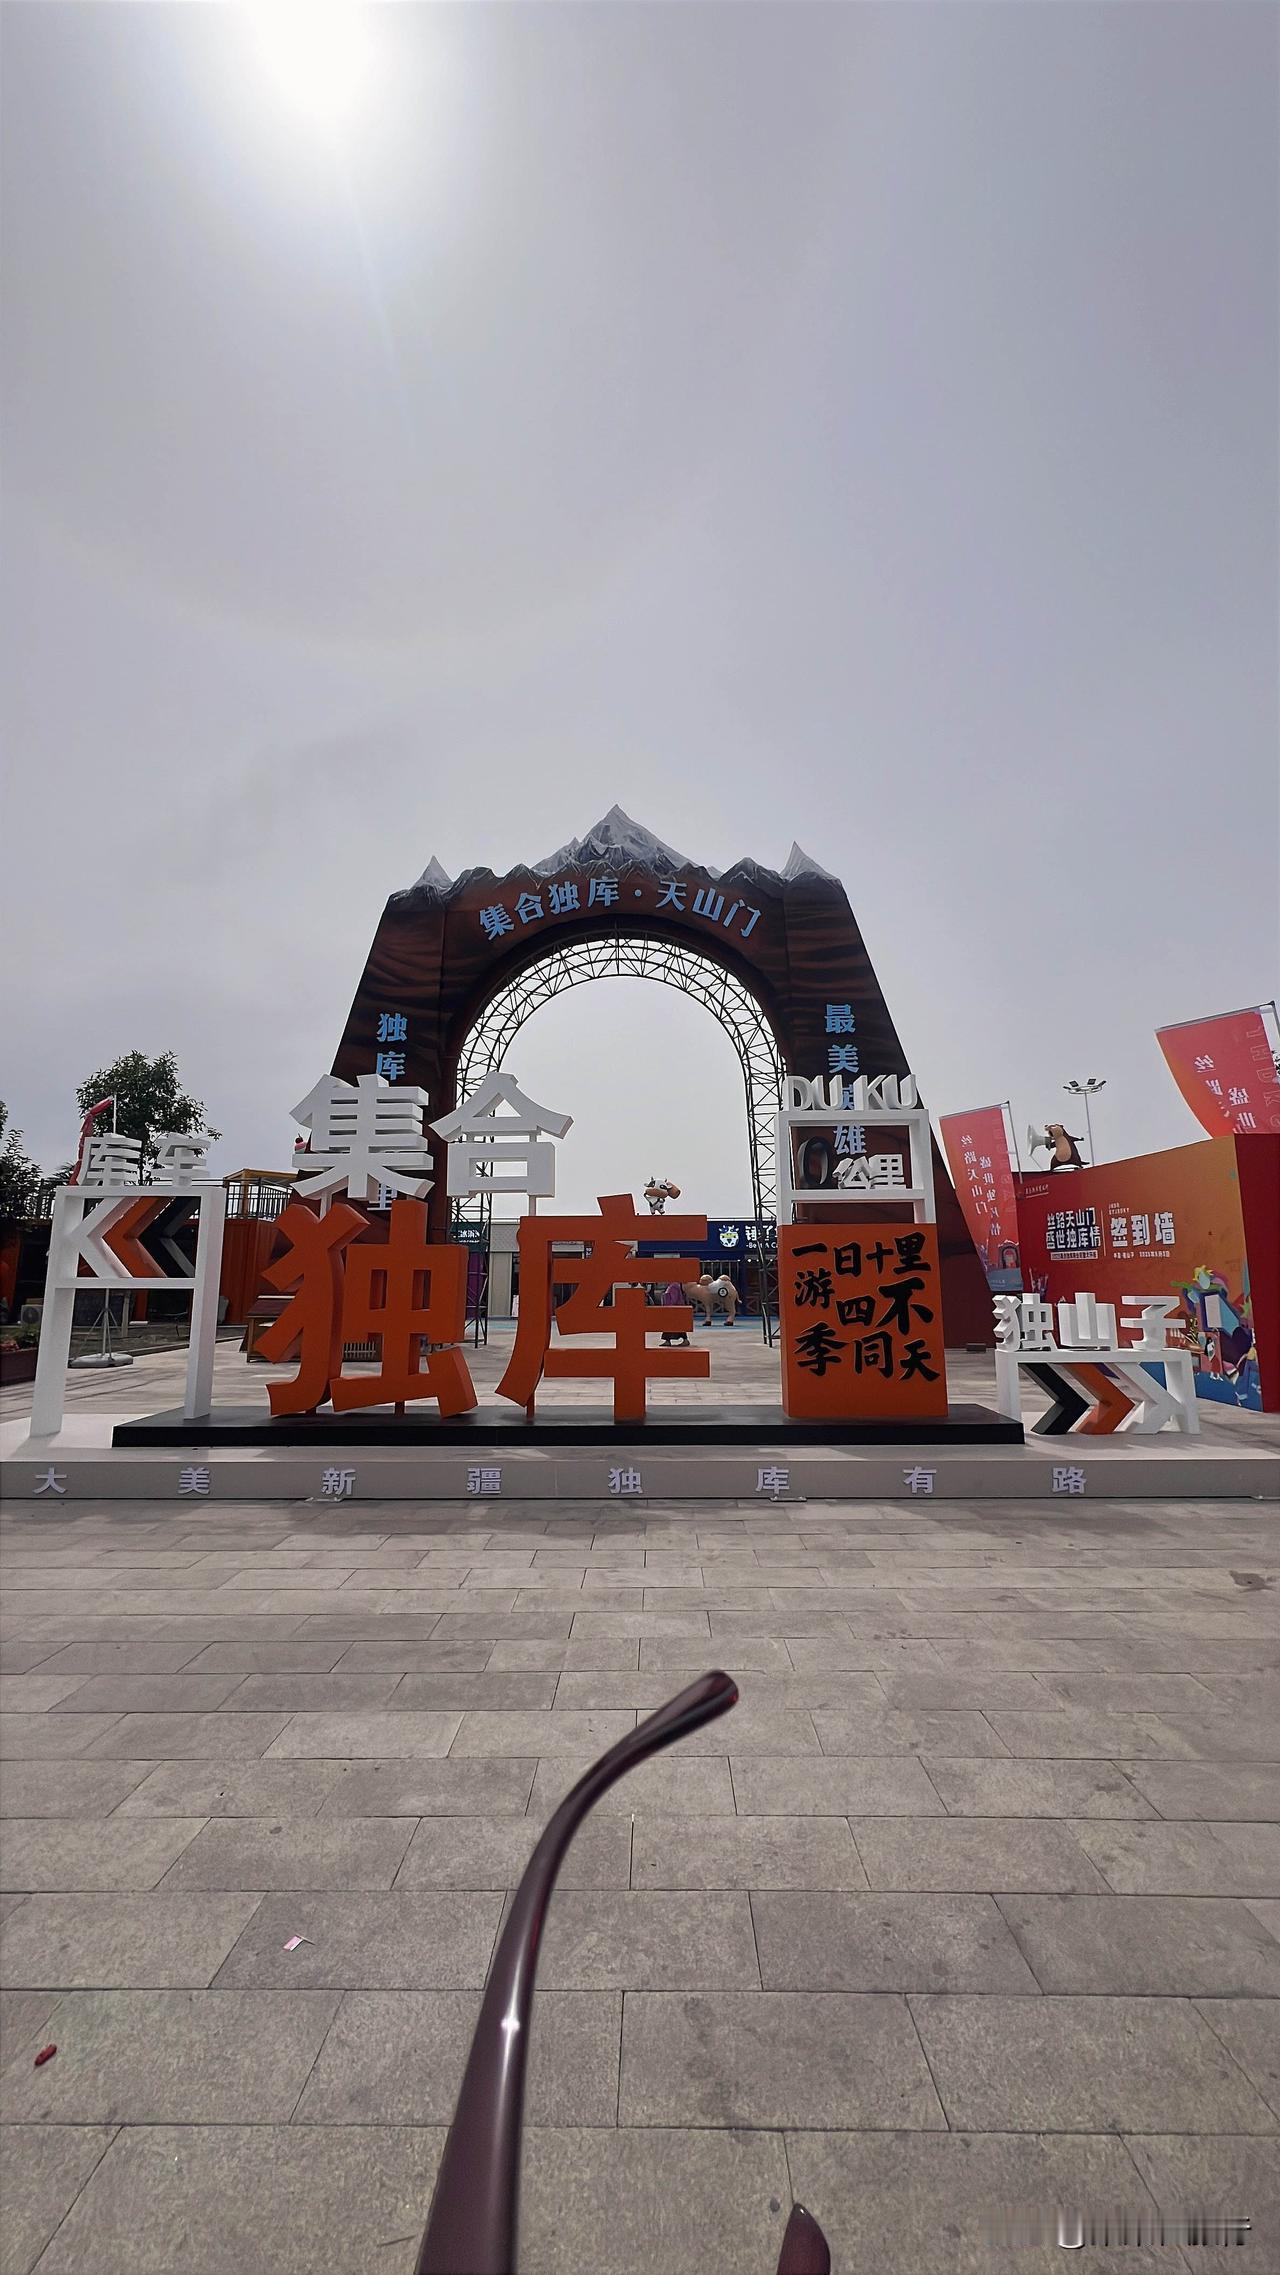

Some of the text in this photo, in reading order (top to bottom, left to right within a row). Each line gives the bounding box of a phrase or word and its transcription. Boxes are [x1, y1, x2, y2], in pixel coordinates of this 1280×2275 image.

[479, 877, 762, 941] 集合独库·天山门
[782, 1074, 917, 1110] DUKU
[76, 1132, 211, 1186] 库车
[290, 1072, 573, 1199] 集合
[1046, 1226, 1101, 1250] 盛世独库情
[1047, 1207, 1096, 1230] 丝路天山门
[1110, 1211, 1176, 1248] 签到墙
[254, 1194, 711, 1418] 独库
[992, 1292, 1186, 1351] 独山子
